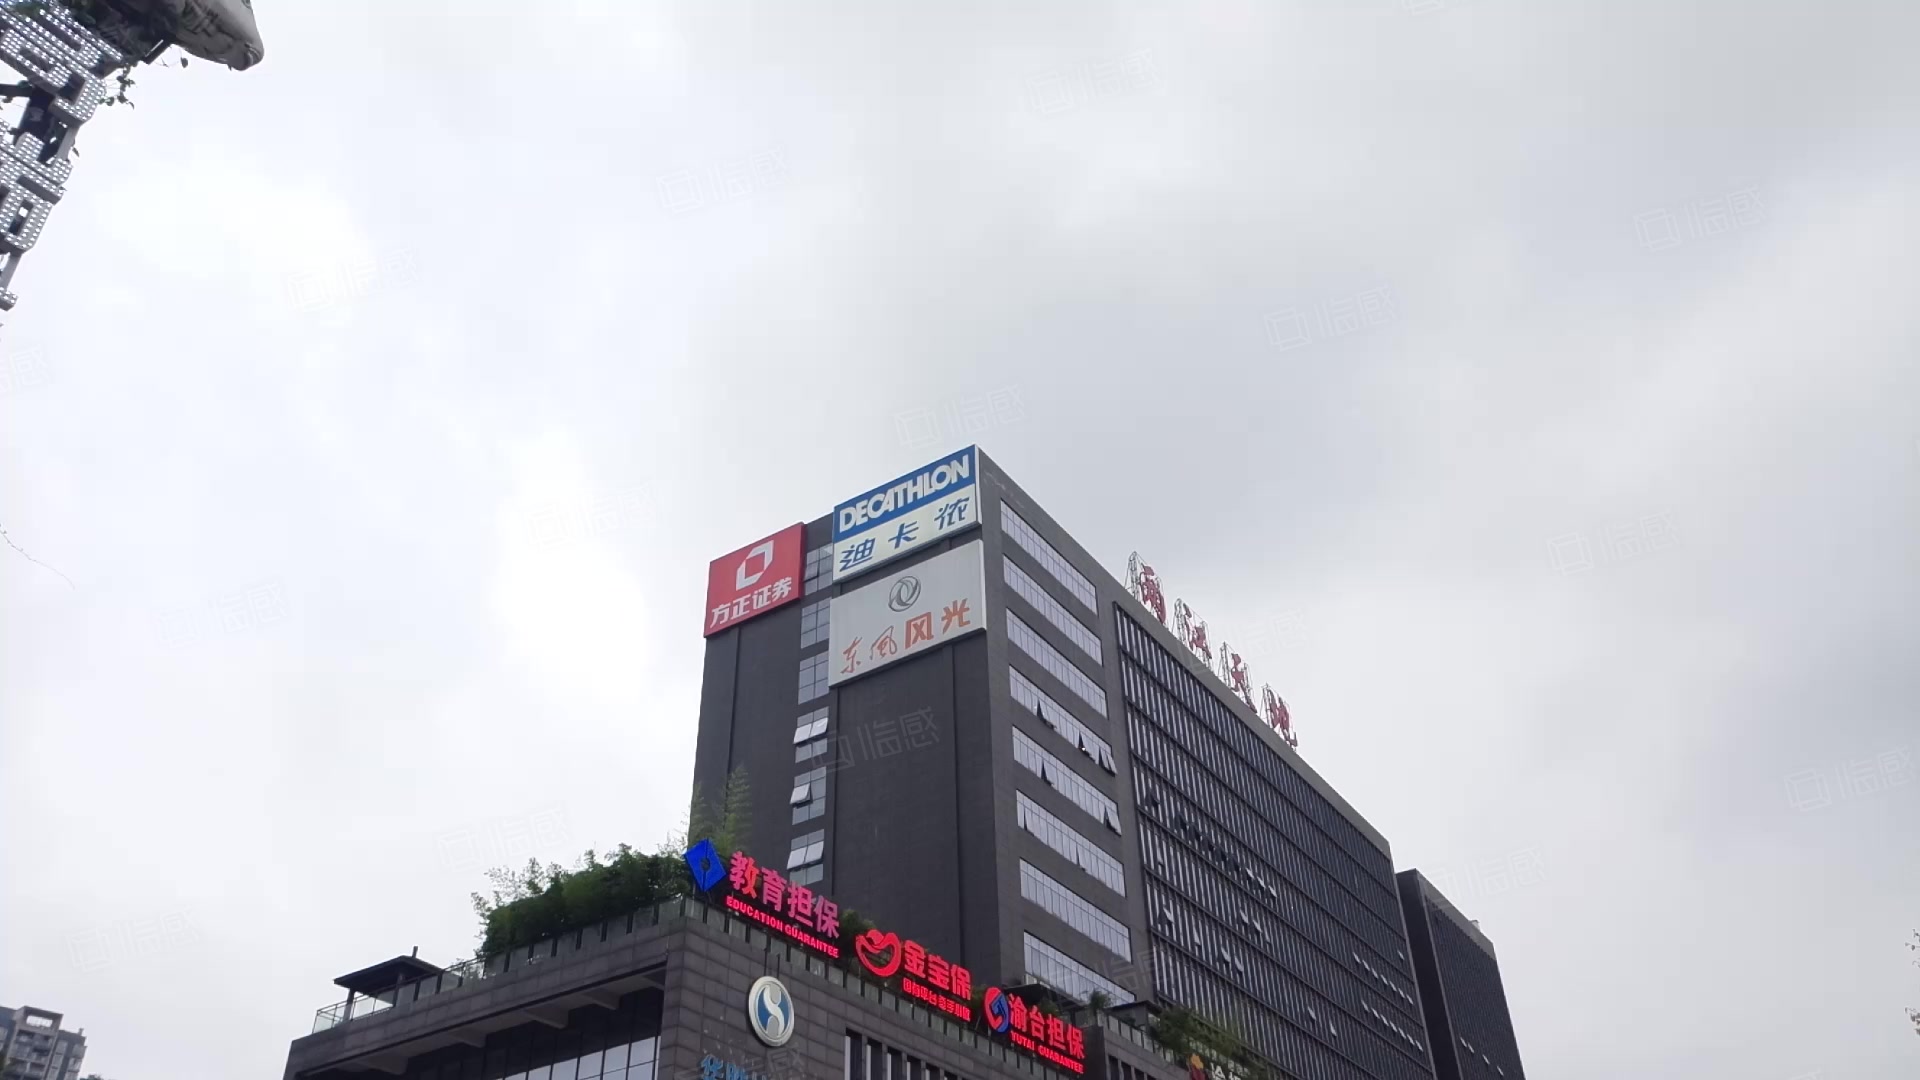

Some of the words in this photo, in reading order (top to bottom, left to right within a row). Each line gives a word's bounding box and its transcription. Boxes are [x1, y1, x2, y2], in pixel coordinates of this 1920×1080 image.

[839, 454, 970, 534] DECATHLON
[839, 496, 970, 571] 迪卡侬
[709, 576, 792, 628] 方正证券
[726, 895, 783, 932] EDUCATION
[785, 923, 840, 960] GUARANTEE
[729, 850, 840, 939] 教育担保
[904, 939, 972, 1001] 金宝保
[1008, 992, 1086, 1060] 渝台担保
[1010, 1029, 1035, 1051] YUTAI
[1037, 1045, 1084, 1075] GUARANTEE
